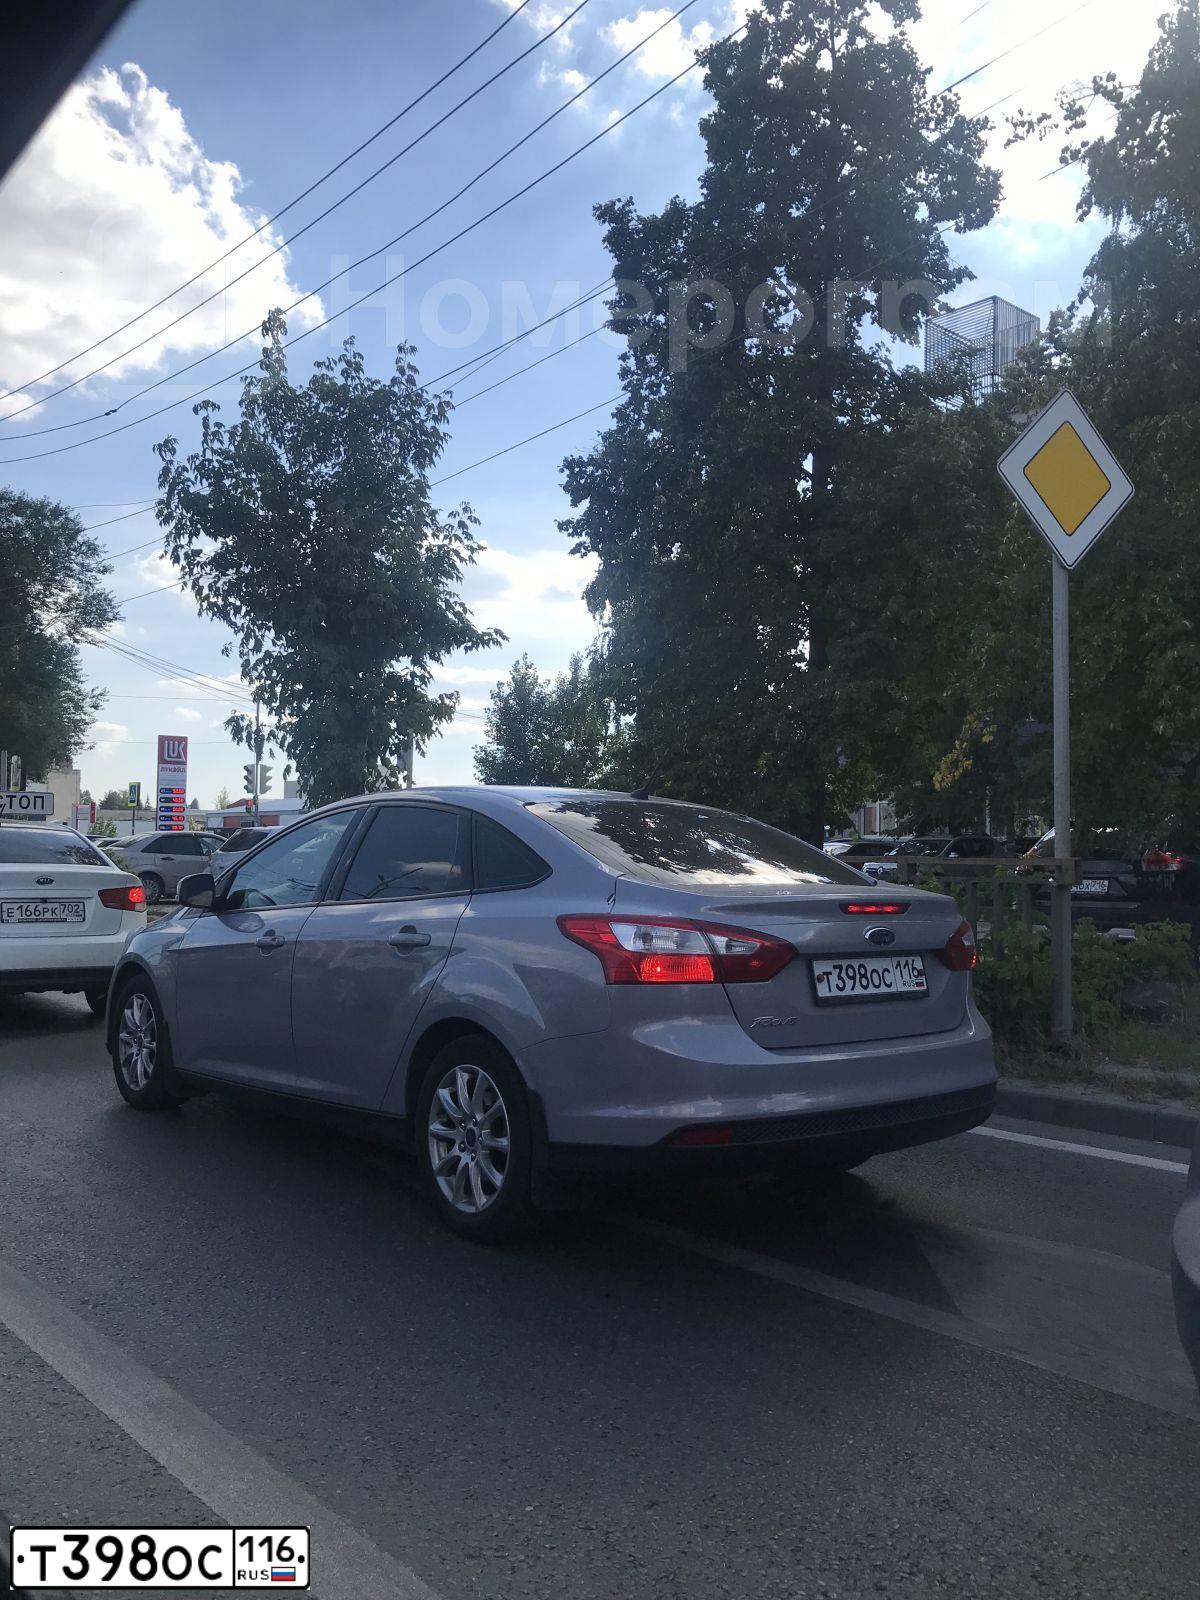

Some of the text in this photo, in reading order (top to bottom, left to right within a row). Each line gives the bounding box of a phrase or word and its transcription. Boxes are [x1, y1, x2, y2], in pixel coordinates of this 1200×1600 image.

[0, 794, 44, 810] ТОП
[60, 903, 80, 914] 702
[822, 960, 920, 993] Т398ОС 116
